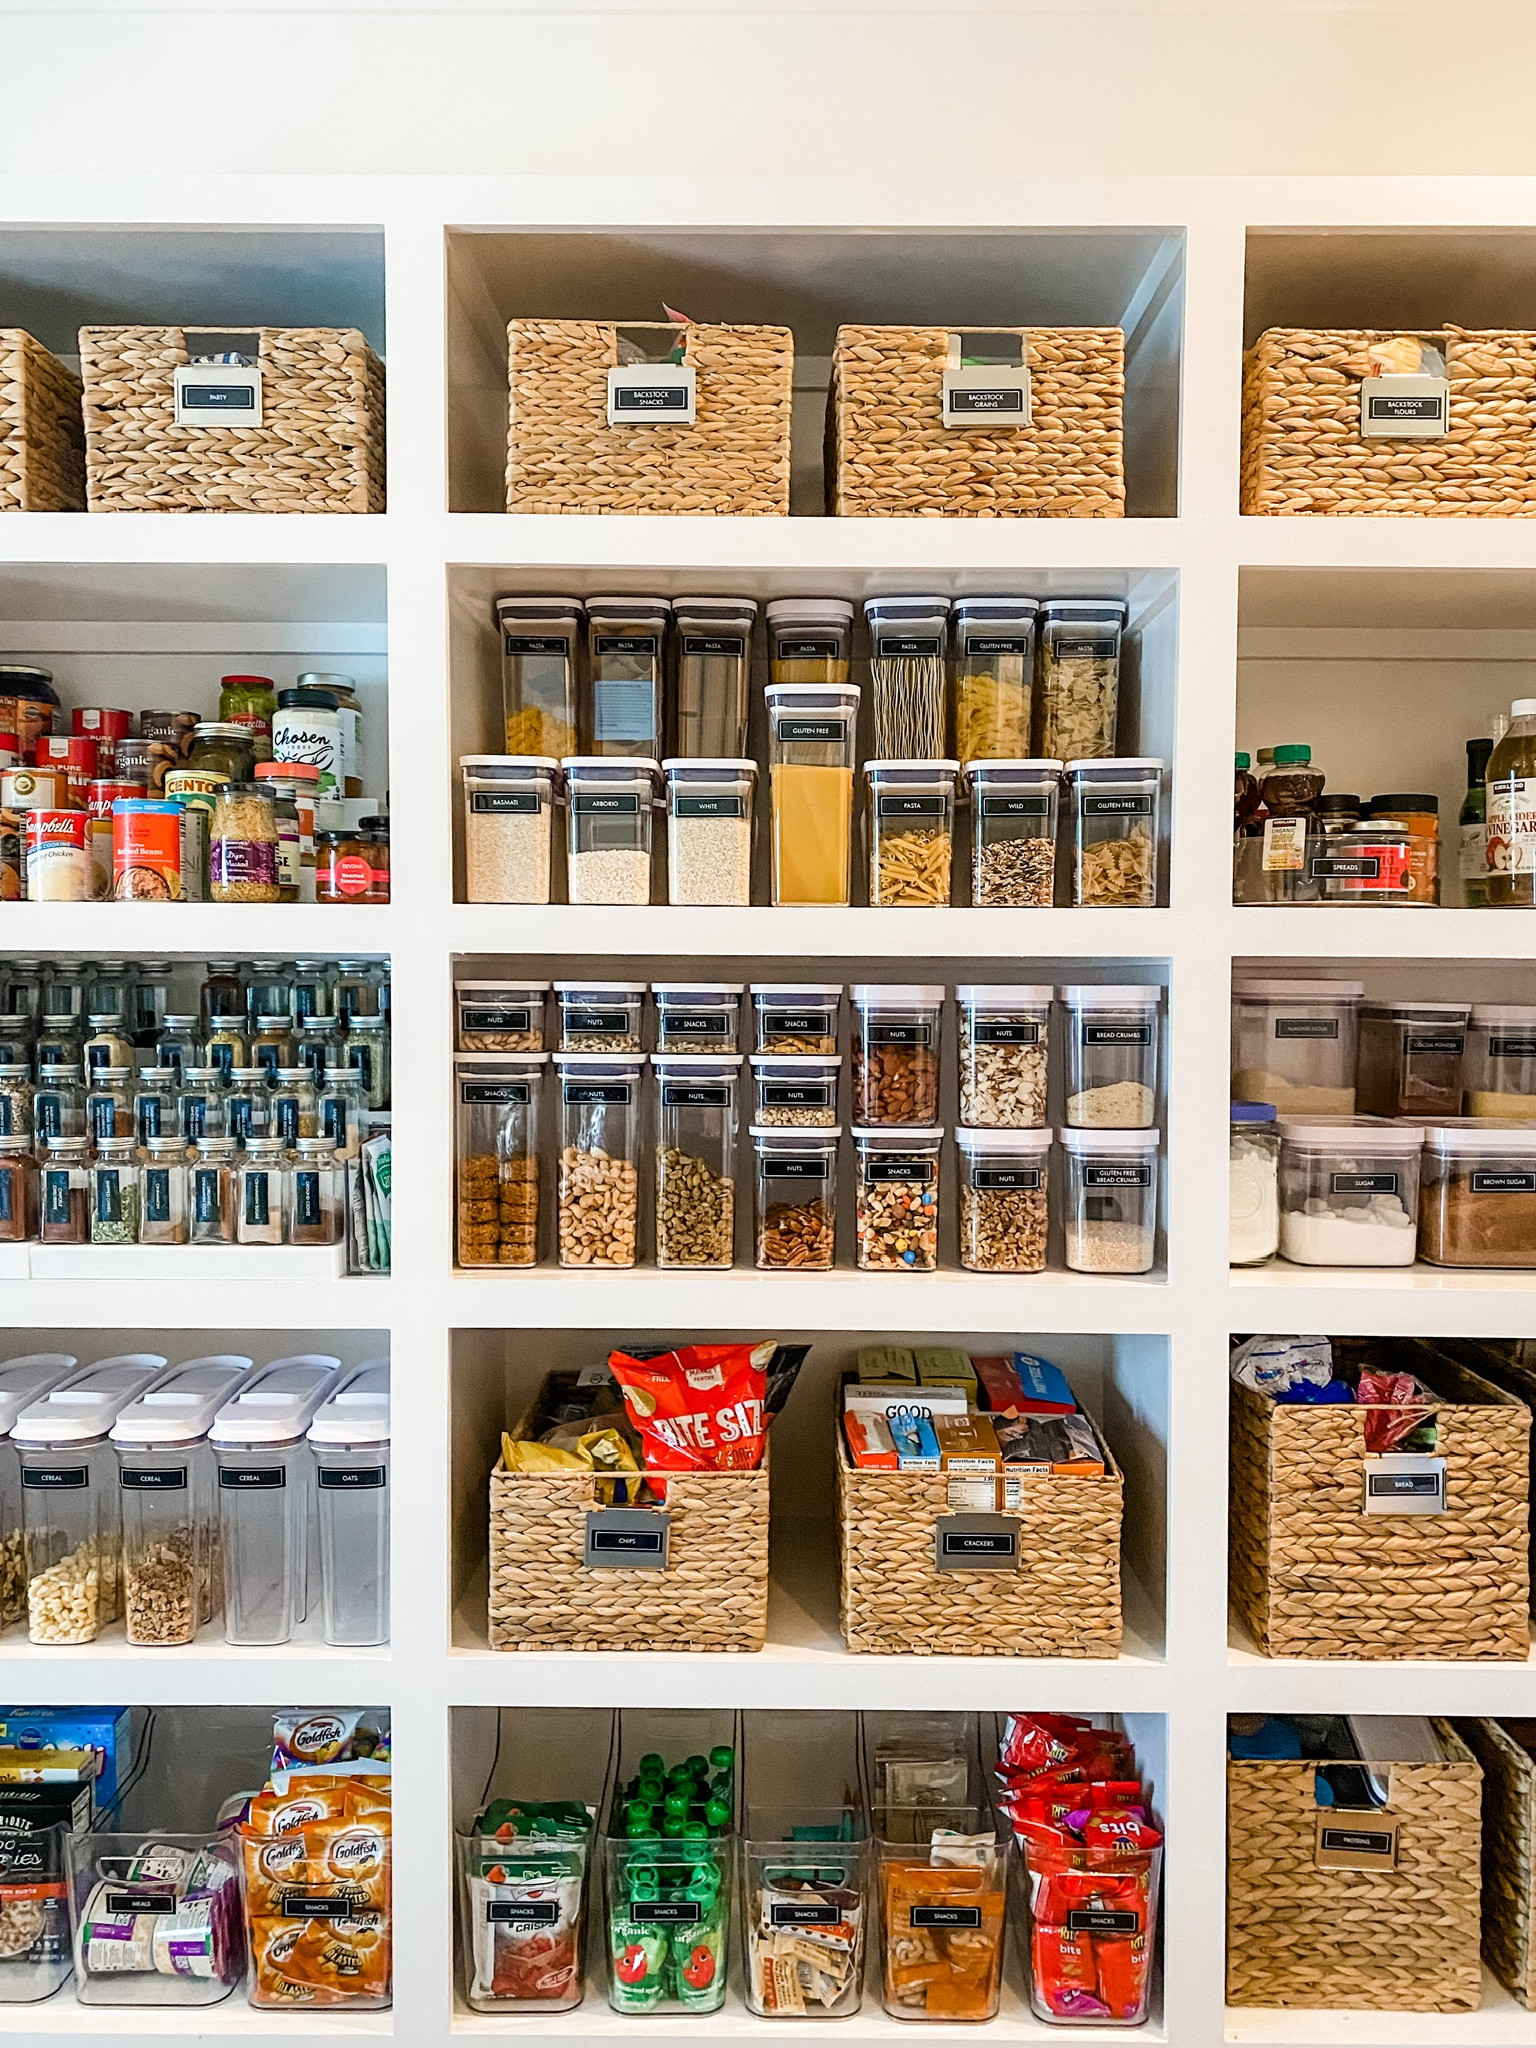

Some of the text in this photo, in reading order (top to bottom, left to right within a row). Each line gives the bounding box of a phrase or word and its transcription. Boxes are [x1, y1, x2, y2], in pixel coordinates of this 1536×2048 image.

[979, 642, 1013, 650] GLUTEN FREE
[144, 726, 178, 738] rganic
[274, 727, 331, 746] Chosen
[116, 755, 149, 768] rganic
[168, 779, 214, 793] CENTO
[1494, 782, 1524, 791] KIRKLND
[1488, 813, 1507, 824] APPLE
[886, 1405, 932, 1420] GOOD
[652, 1399, 765, 1448] BITE SIZ
[297, 1727, 341, 1746] Goldfish
[10, 1816, 34, 1831] OATS
[1099, 1821, 1140, 1836] bits
[335, 1841, 378, 1860] Goldfish
[516, 1922, 556, 1933] CRISPS
[1060, 1944, 1082, 1955] bits
[325, 1947, 363, 1967] BLASTED
